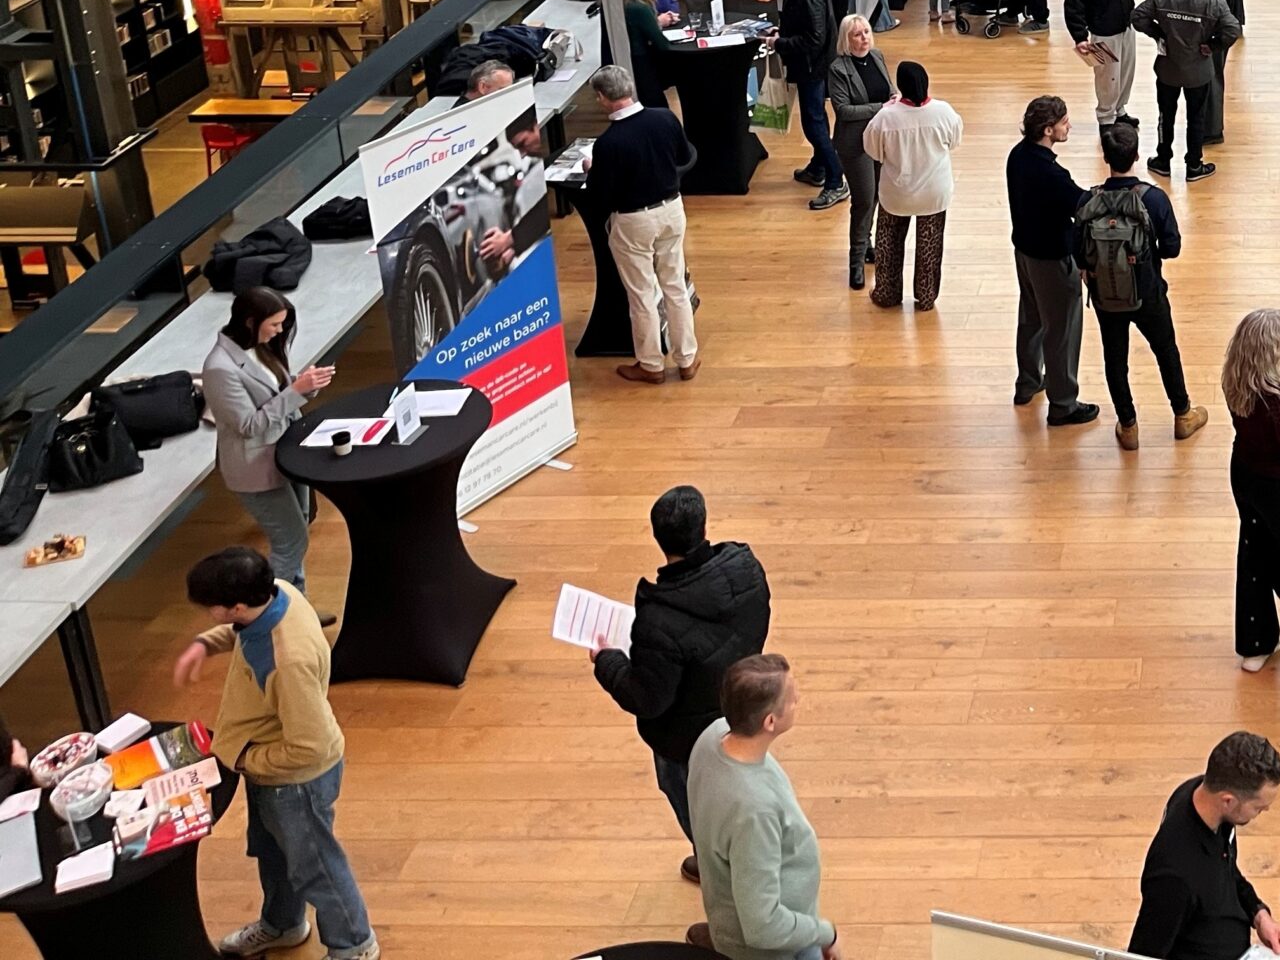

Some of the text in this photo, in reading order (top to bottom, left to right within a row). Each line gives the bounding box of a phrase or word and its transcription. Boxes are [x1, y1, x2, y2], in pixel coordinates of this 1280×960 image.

[377, 138, 475, 188] Leseman Car Care
[436, 296, 549, 364] Op zoek naar een
[464, 311, 551, 369] nieuwe baan?
